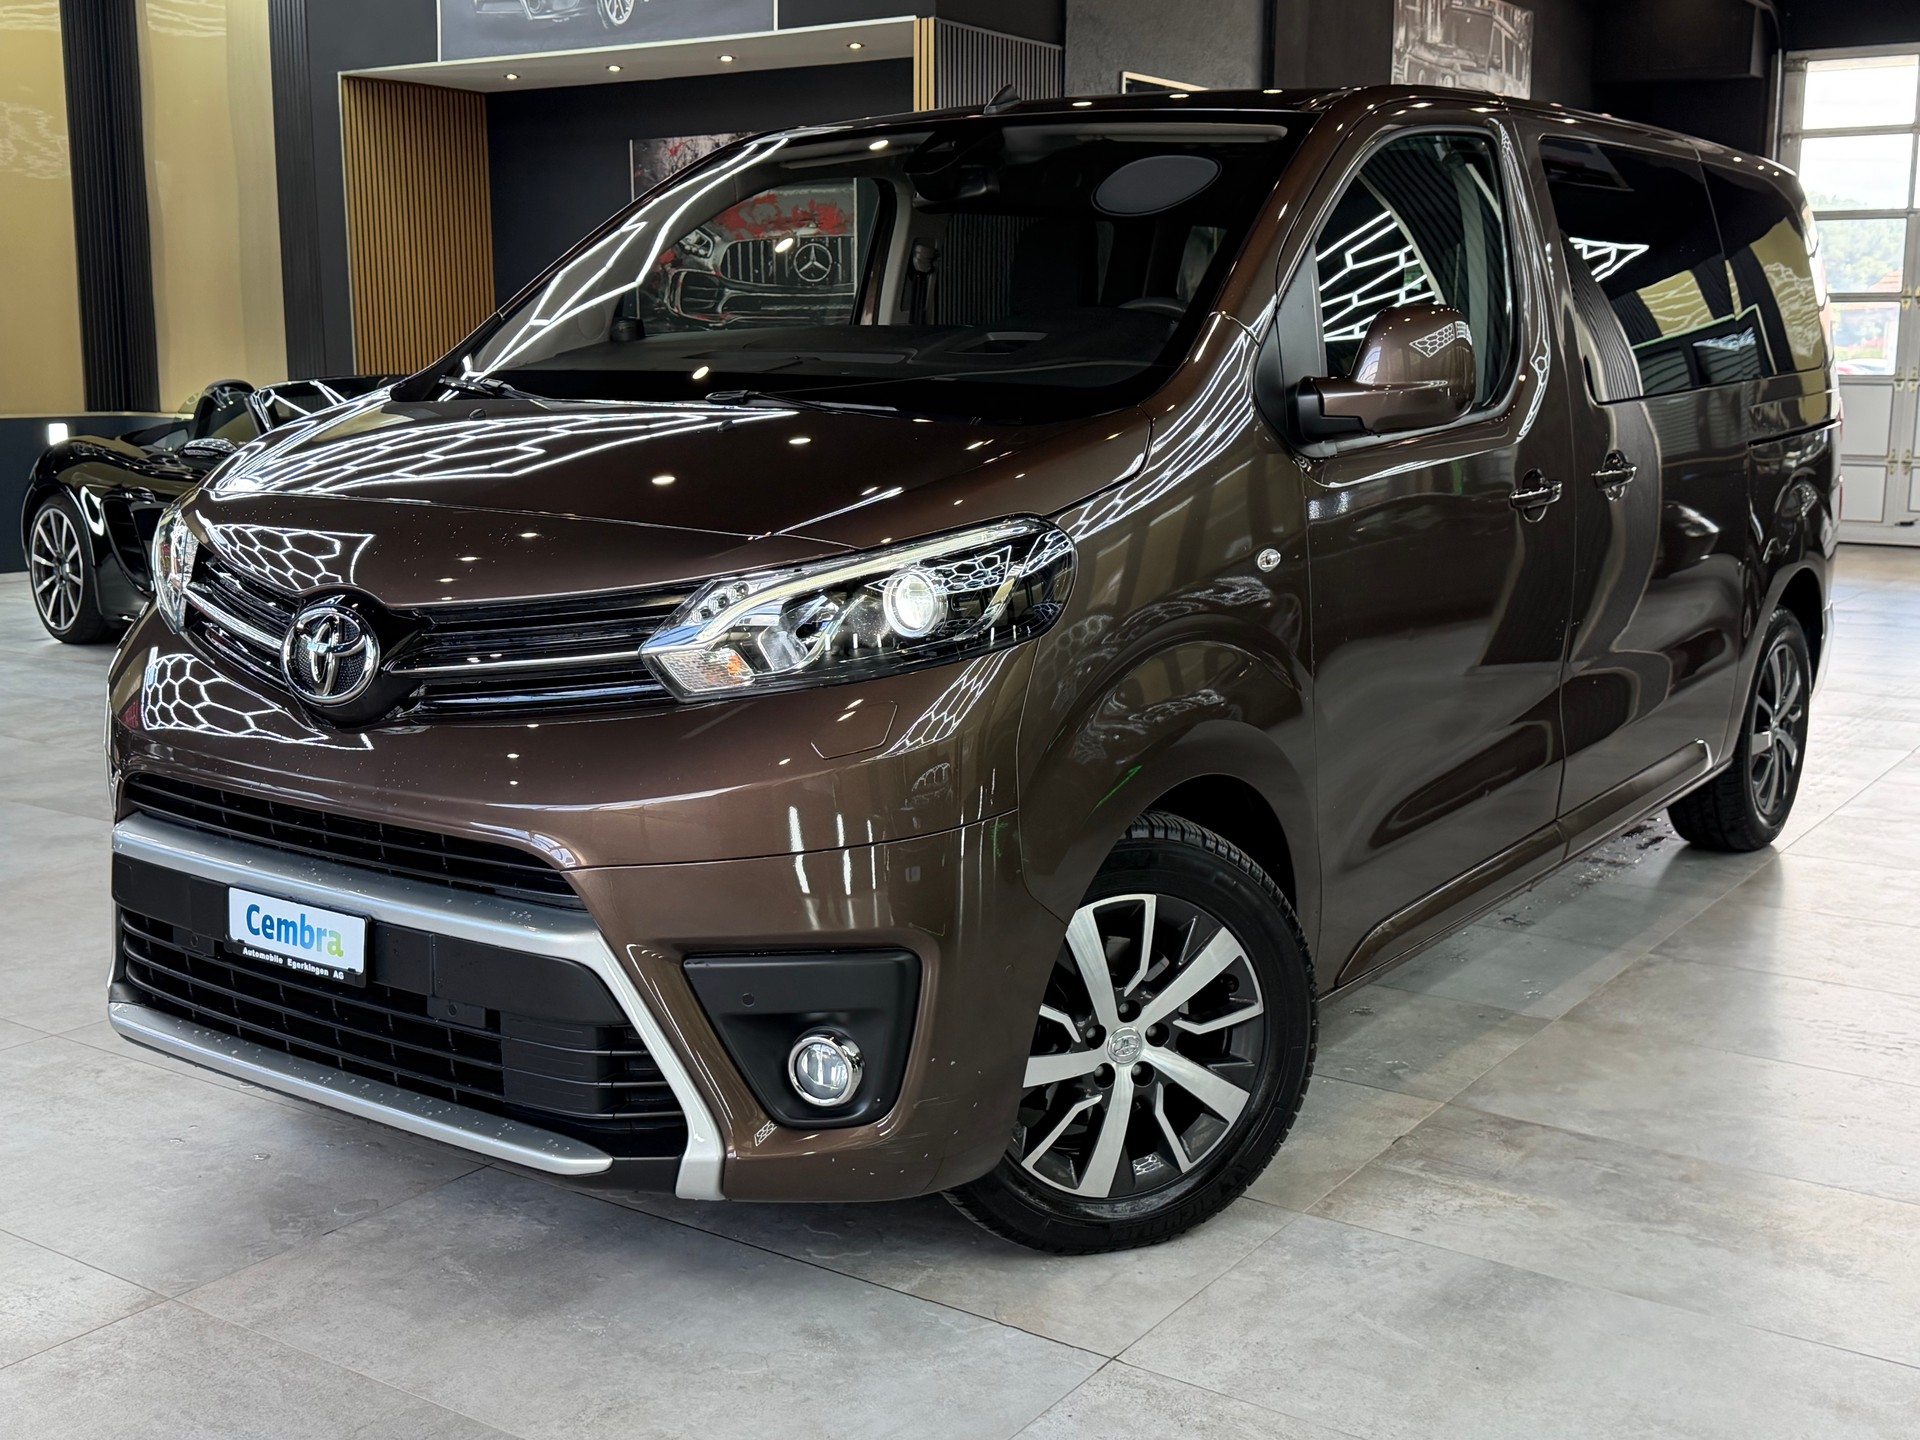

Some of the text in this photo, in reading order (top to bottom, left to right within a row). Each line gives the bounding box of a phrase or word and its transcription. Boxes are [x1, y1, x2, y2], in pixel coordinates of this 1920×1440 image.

[246, 904, 344, 957] Cembra
[242, 947, 344, 980] Automobile Egerkingen AG
